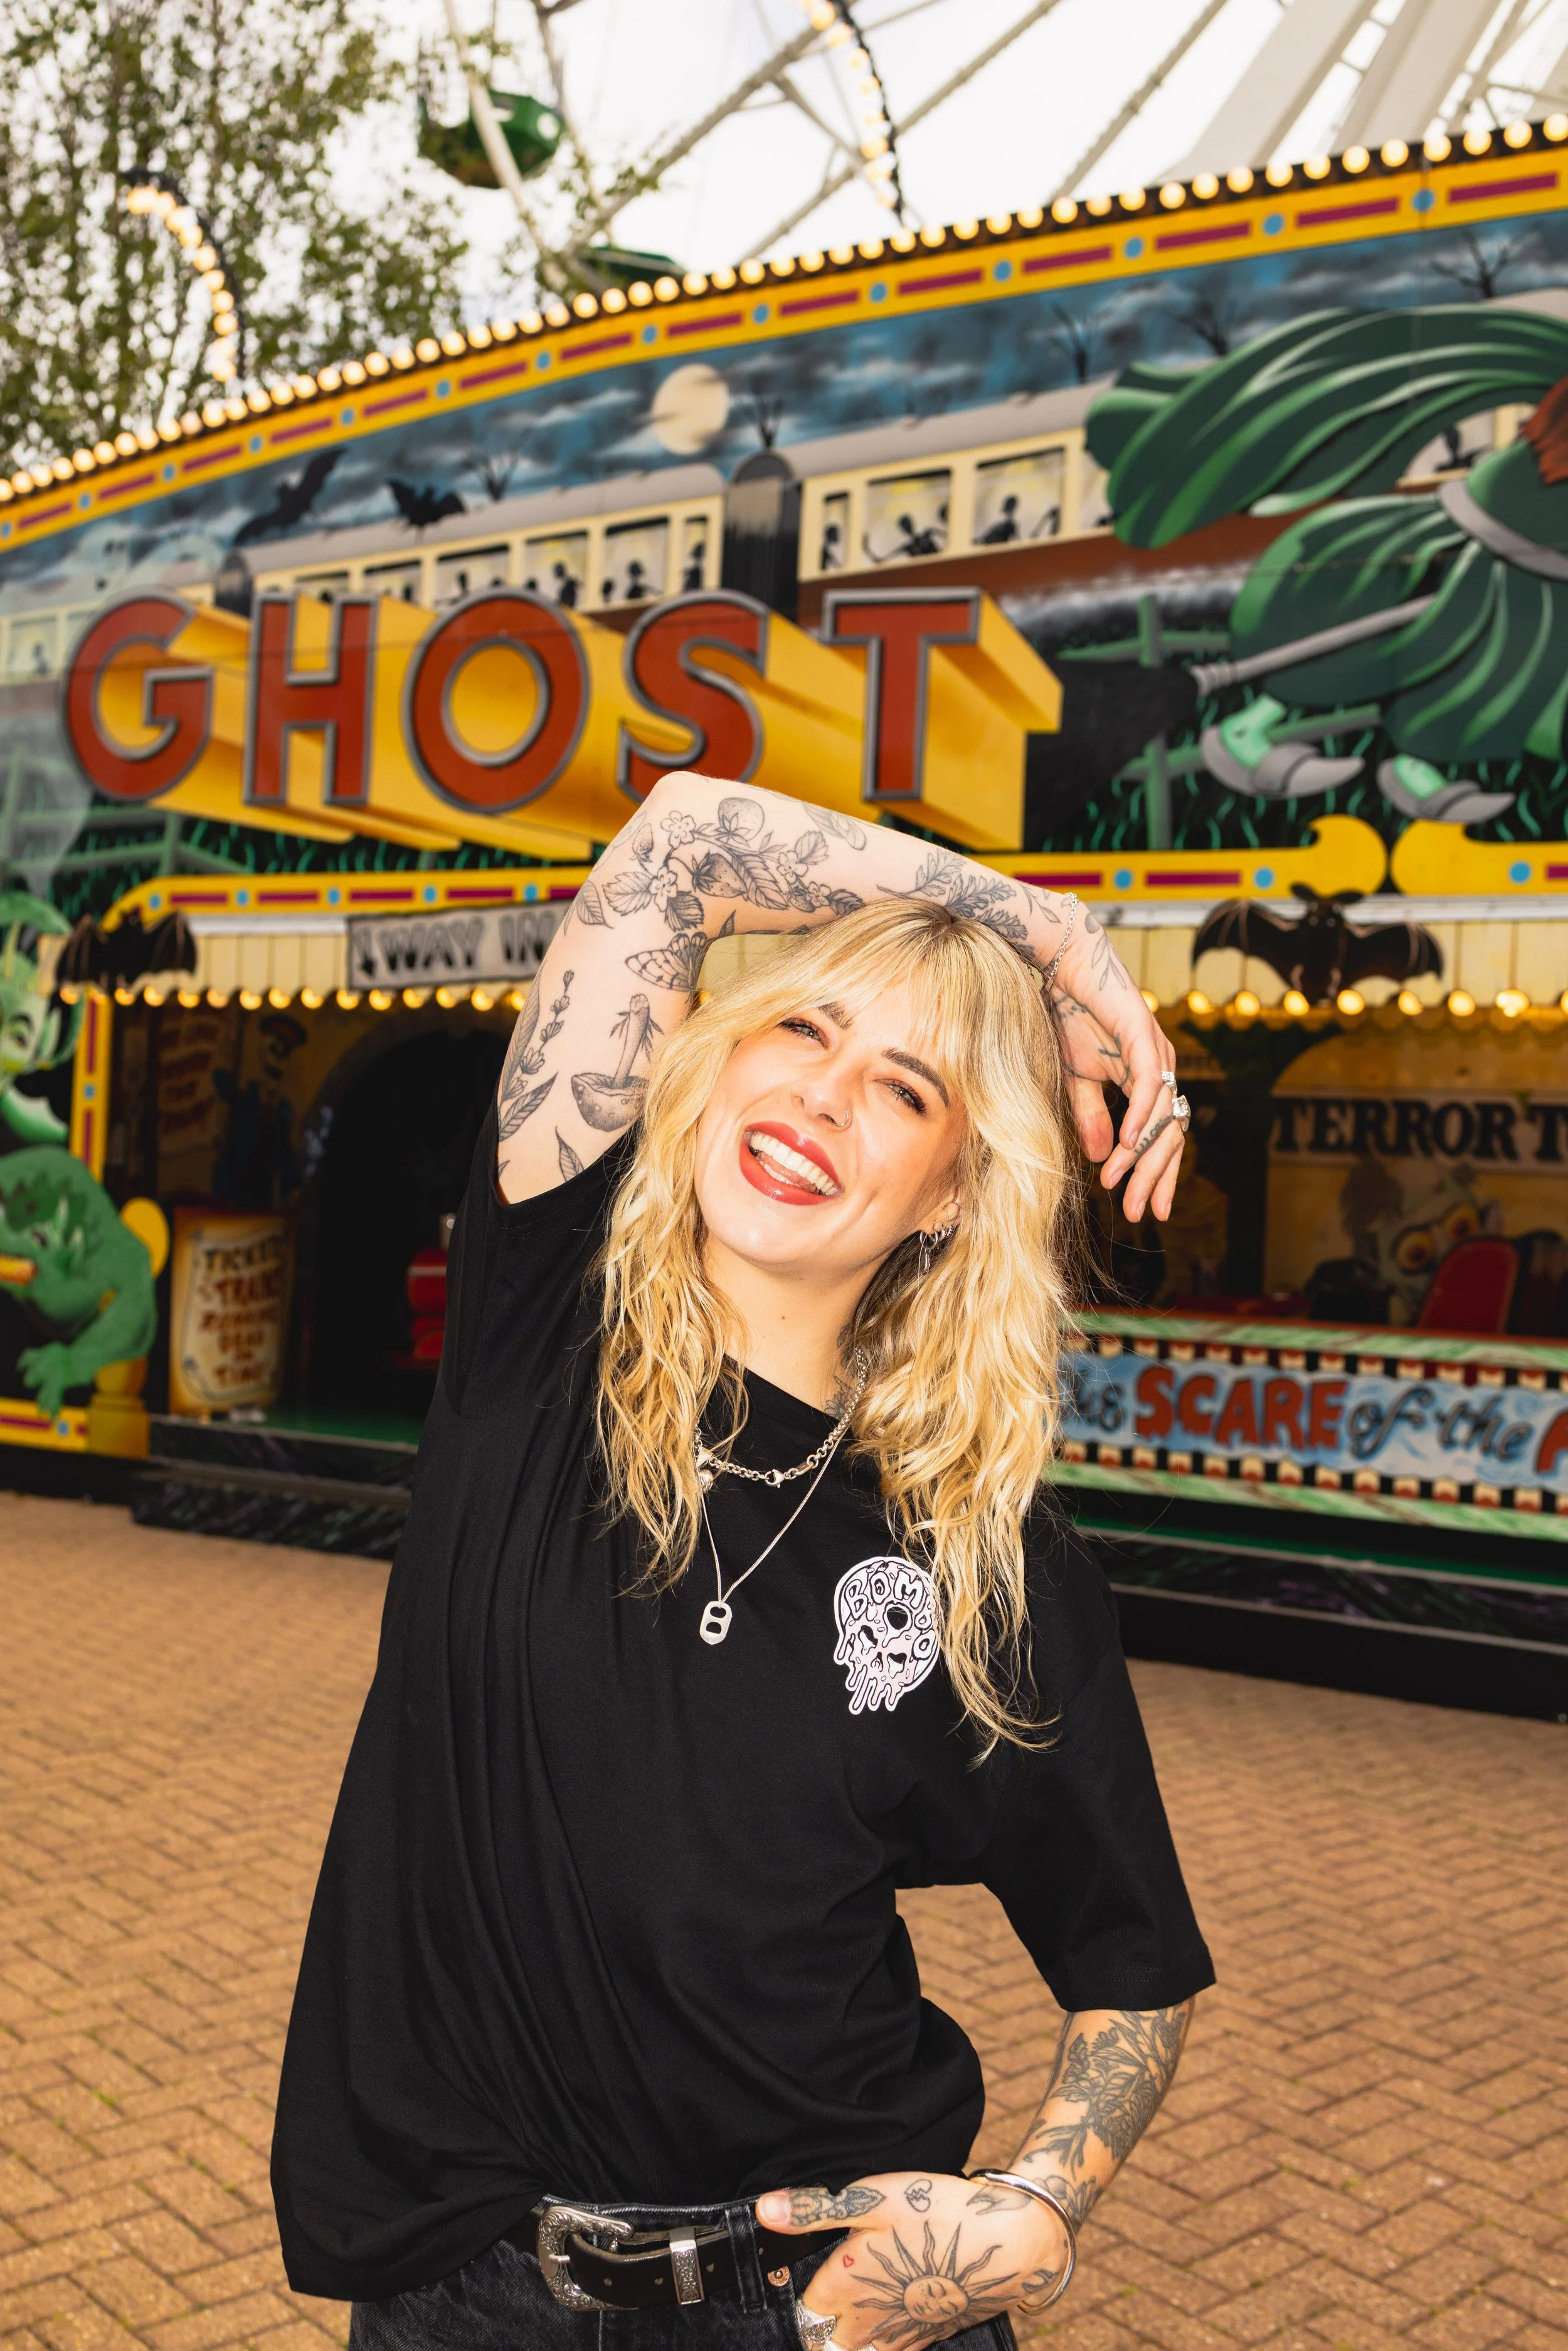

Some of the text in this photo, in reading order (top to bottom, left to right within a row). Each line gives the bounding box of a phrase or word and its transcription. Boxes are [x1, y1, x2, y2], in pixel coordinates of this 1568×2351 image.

[61, 585, 983, 815] GHOST
[378, 915, 485, 972] WAY
[1269, 1096, 1518, 1161] TERROR
[1136, 1366, 1348, 1451] SCARE
[1348, 1384, 1434, 1460] of
[1434, 1394, 1533, 1460] the
